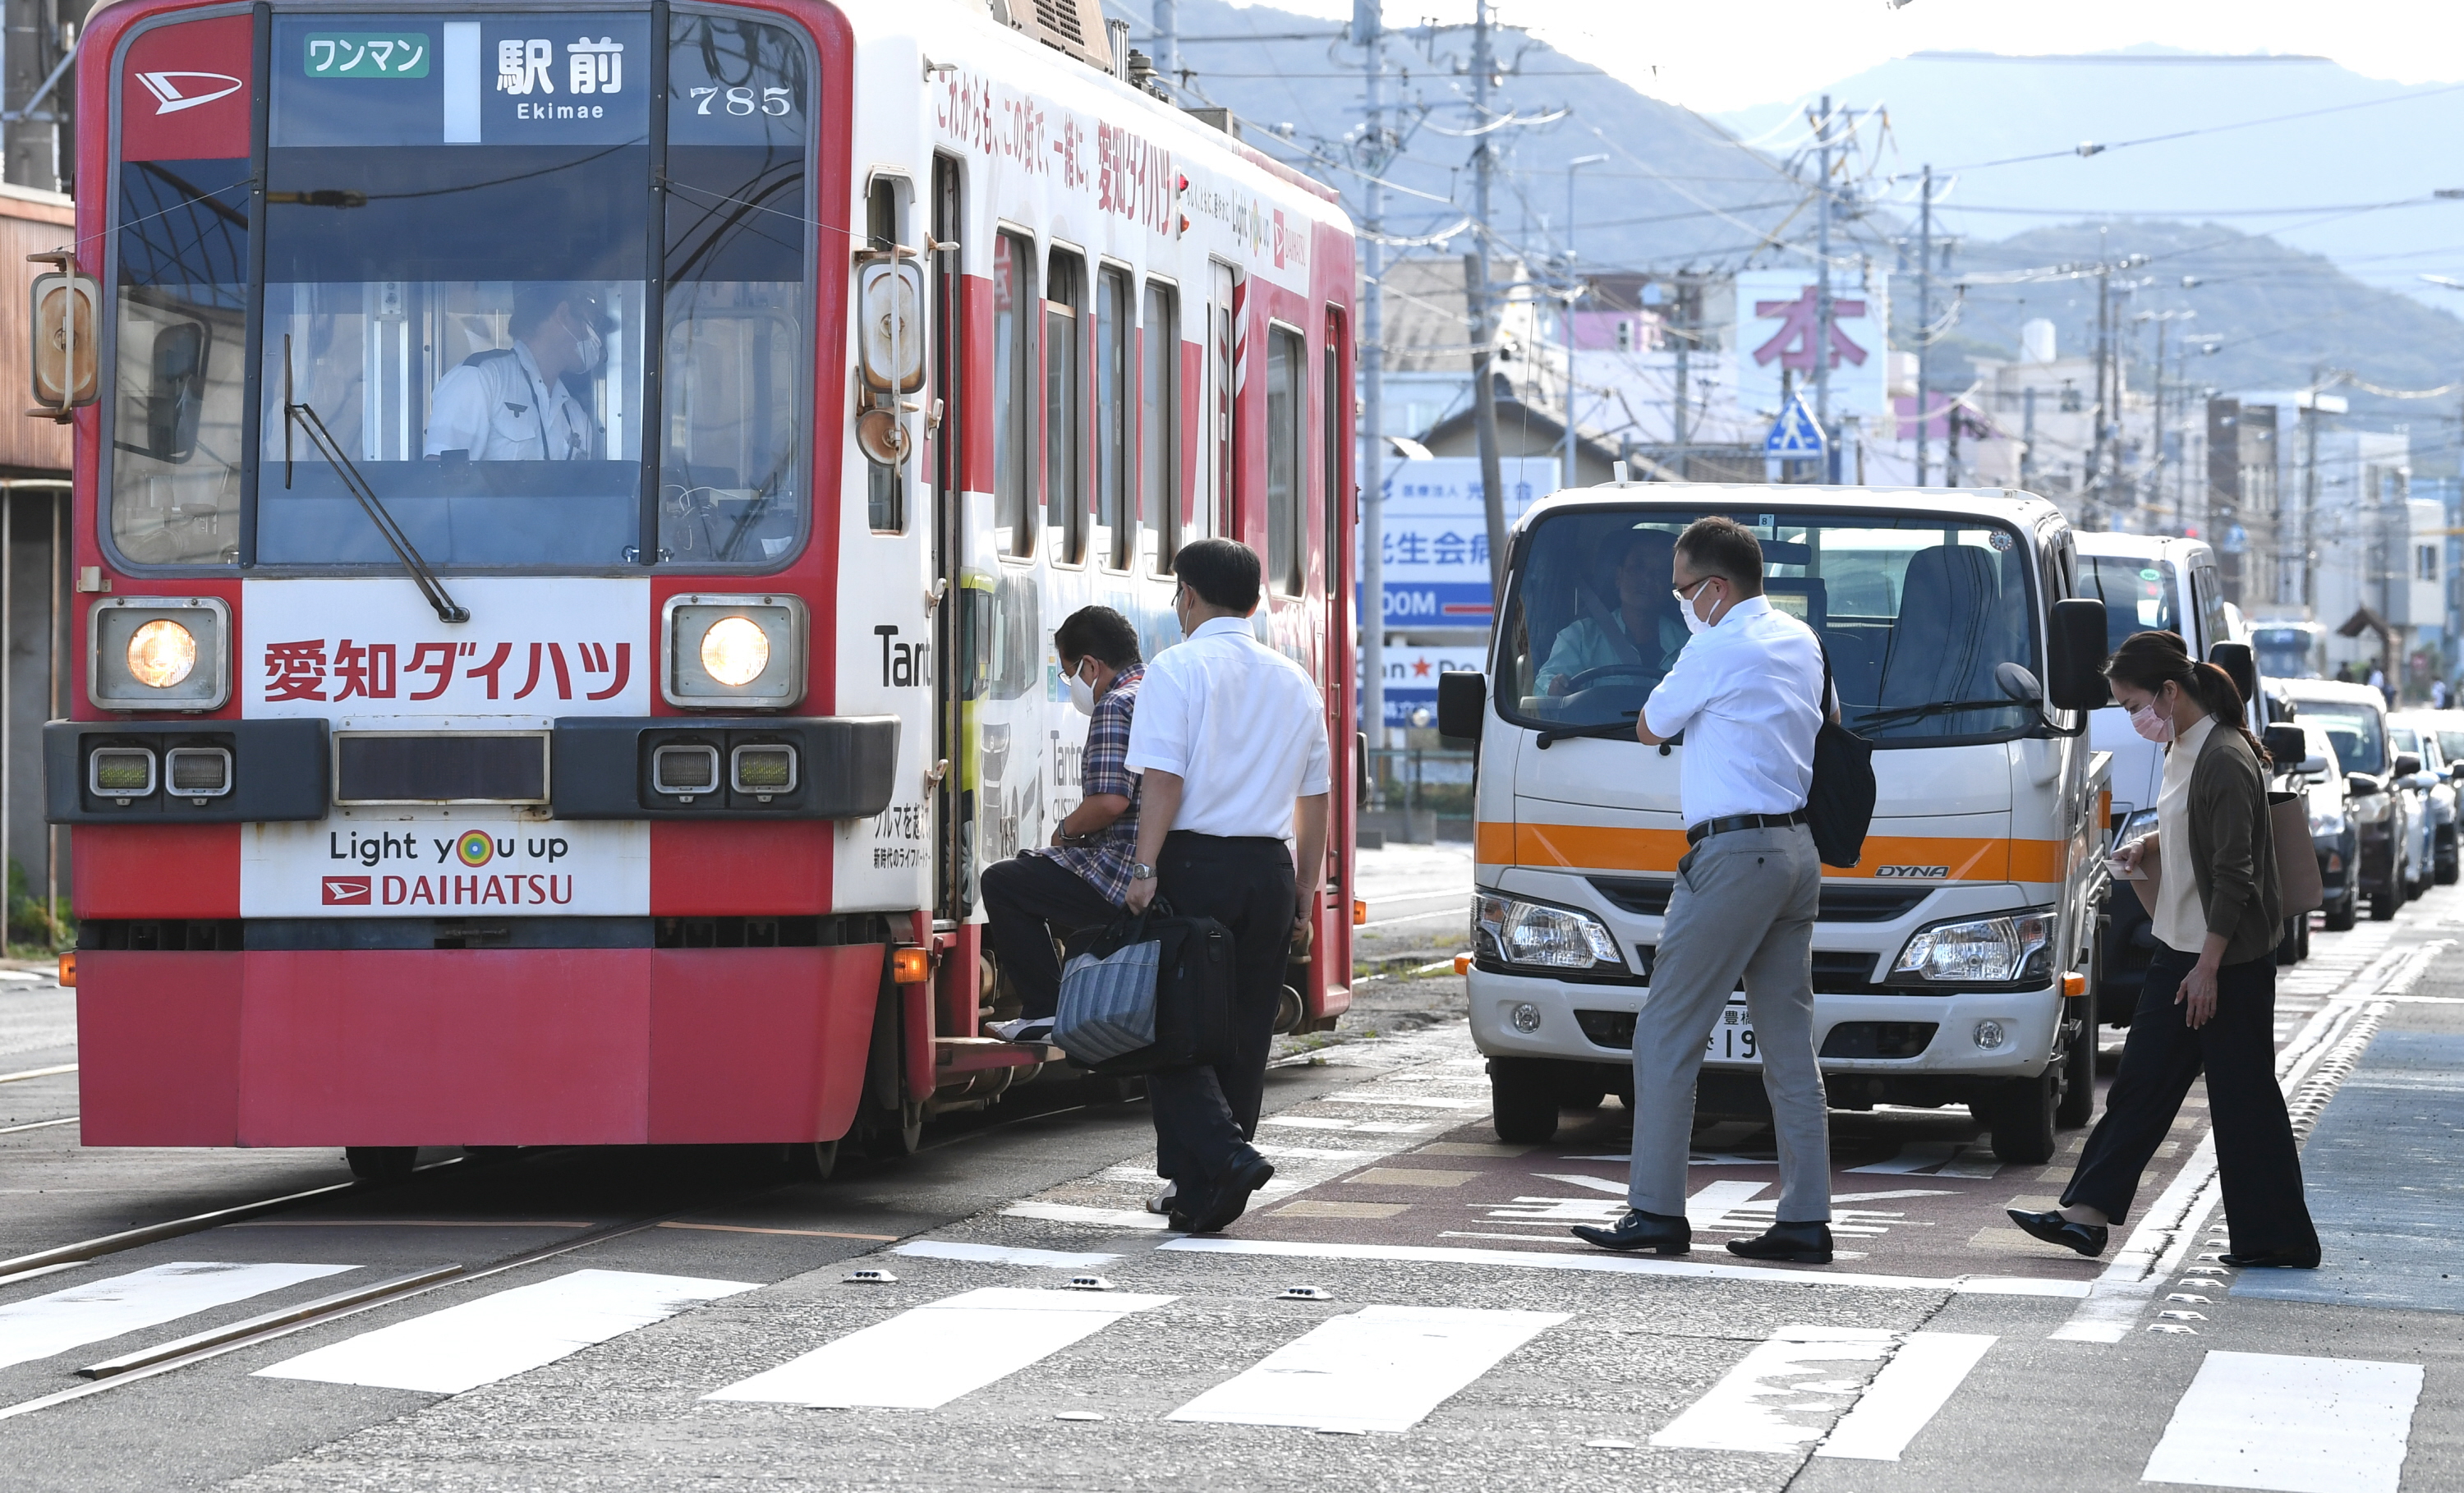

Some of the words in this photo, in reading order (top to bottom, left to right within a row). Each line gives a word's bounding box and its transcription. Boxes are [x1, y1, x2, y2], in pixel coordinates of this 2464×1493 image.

[310, 39, 423, 72] ワンマン
[496, 37, 624, 94] 駅前
[517, 103, 605, 120] Ekimae
[690, 86, 790, 116] 785
[1098, 117, 1170, 237] 愛知ダイハツ
[1232, 189, 1248, 247] Light
[1752, 285, 1869, 384] 本
[264, 637, 631, 704] 愛知ダイハツ
[874, 625, 932, 687] Tant
[330, 831, 419, 867] Light
[433, 829, 515, 868] you
[528, 837, 569, 864] up
[1875, 866, 1950, 877] DYNA
[382, 874, 572, 905] DAIHATSU
